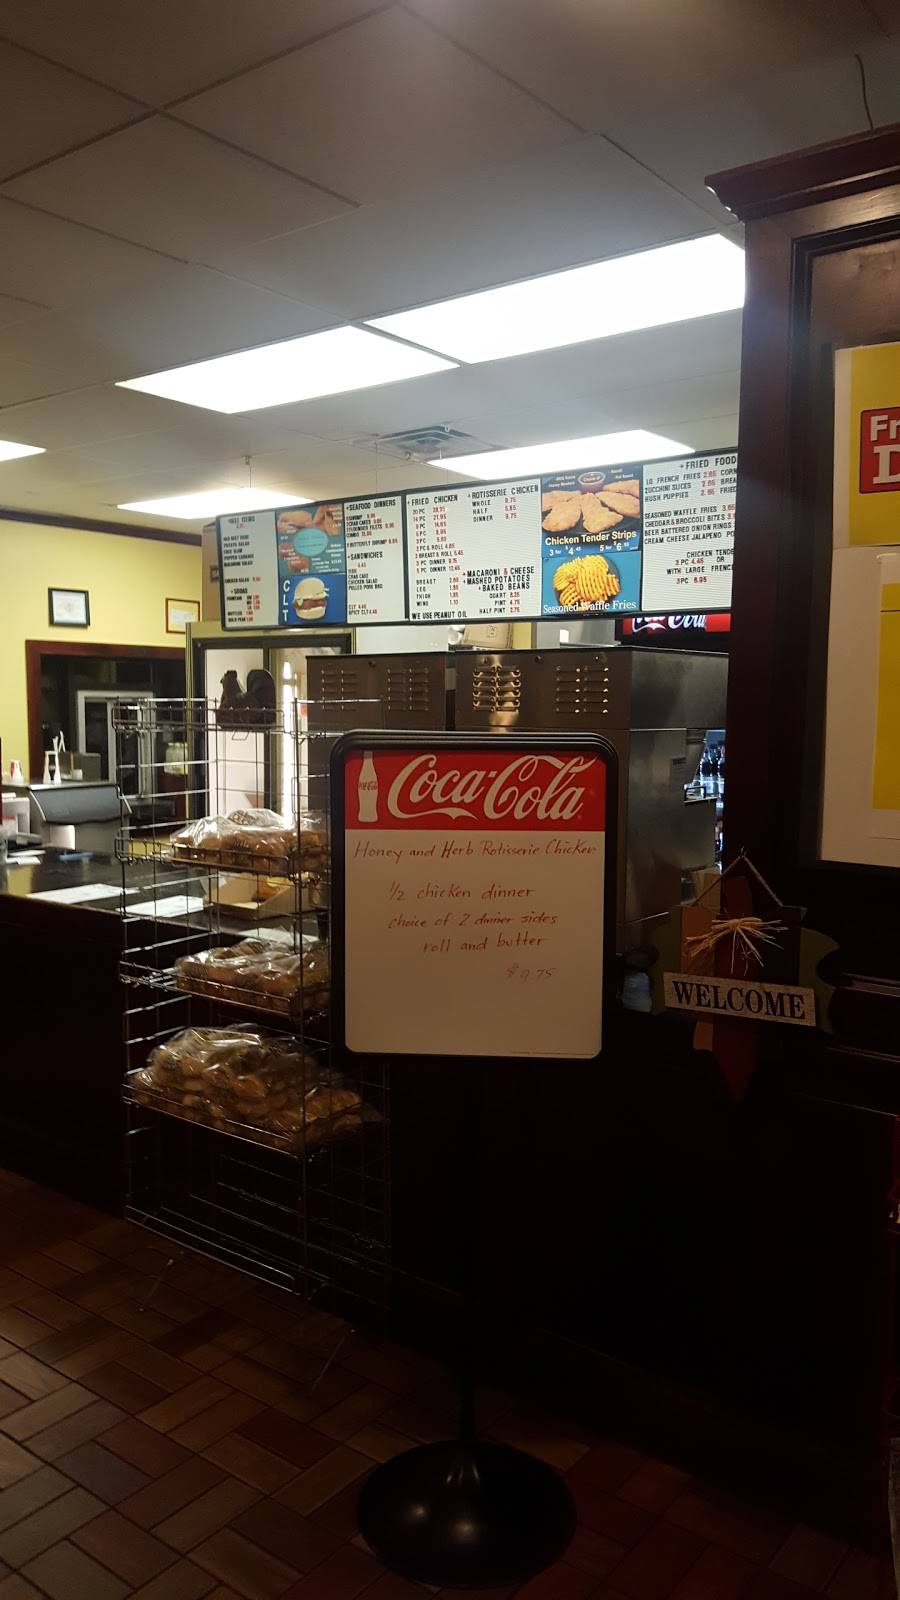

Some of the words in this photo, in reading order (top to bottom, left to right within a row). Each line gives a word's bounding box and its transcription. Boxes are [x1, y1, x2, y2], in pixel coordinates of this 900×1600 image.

[686, 459, 709, 469] FRIED
[657, 475, 679, 483] FRENCH
[683, 472, 701, 480] FRIES
[472, 488, 506, 499] ROTISSERIE
[511, 485, 538, 495] CHICKEN
[645, 485, 670, 494] ZUCCHINI
[412, 497, 429, 506] FRIED
[434, 494, 458, 504] CHICKEN
[645, 494, 661, 502] HUSH
[663, 492, 688, 500] PUPPIES
[349, 502, 371, 510] SEAFOOD
[374, 499, 396, 508] DINNERS
[645, 511, 672, 519] SEASONED
[673, 508, 697, 516] WAFFLE
[645, 519, 670, 528] CHEDDAR
[676, 516, 705, 525] BROCCOLI
[661, 526, 690, 535] BATTERED
[691, 524, 711, 532] ONION
[545, 536, 579, 545] Chicken
[581, 533, 609, 542] Tender
[612, 530, 637, 540] Strips
[645, 537, 664, 545] CREAM
[692, 532, 722, 540] JALAPENO
[351, 551, 383, 560] SANDWICHES
[686, 550, 713, 558] CHICKEN
[467, 568, 500, 577] MACARONI
[510, 566, 534, 574] CHEESE
[467, 576, 492, 585] MASHED
[495, 574, 530, 583] POTATOES
[482, 583, 504, 592] BAKED
[508, 582, 530, 590] BEANS
[543, 602, 579, 613] Seasoned
[580, 600, 610, 611] Waffle
[612, 600, 637, 609] Fries
[434, 611, 455, 619] PEANUT
[387, 754, 599, 821] Coca-Cola
[353, 841, 402, 864] Honey
[409, 842, 436, 858] and
[441, 839, 473, 859] Herb
[480, 839, 540, 857] Rotisserie
[545, 838, 597, 856] Chicken
[416, 882, 471, 900] chicken
[481, 883, 535, 900] dinner
[388, 914, 427, 929] choice
[434, 912, 452, 927] of
[458, 913, 471, 927] 2
[474, 911, 513, 925] dinner
[521, 911, 559, 925] sides
[423, 938, 451, 953] roll
[460, 936, 488, 951] and
[496, 931, 547, 947] butter
[672, 980, 805, 1019] WELCOME
